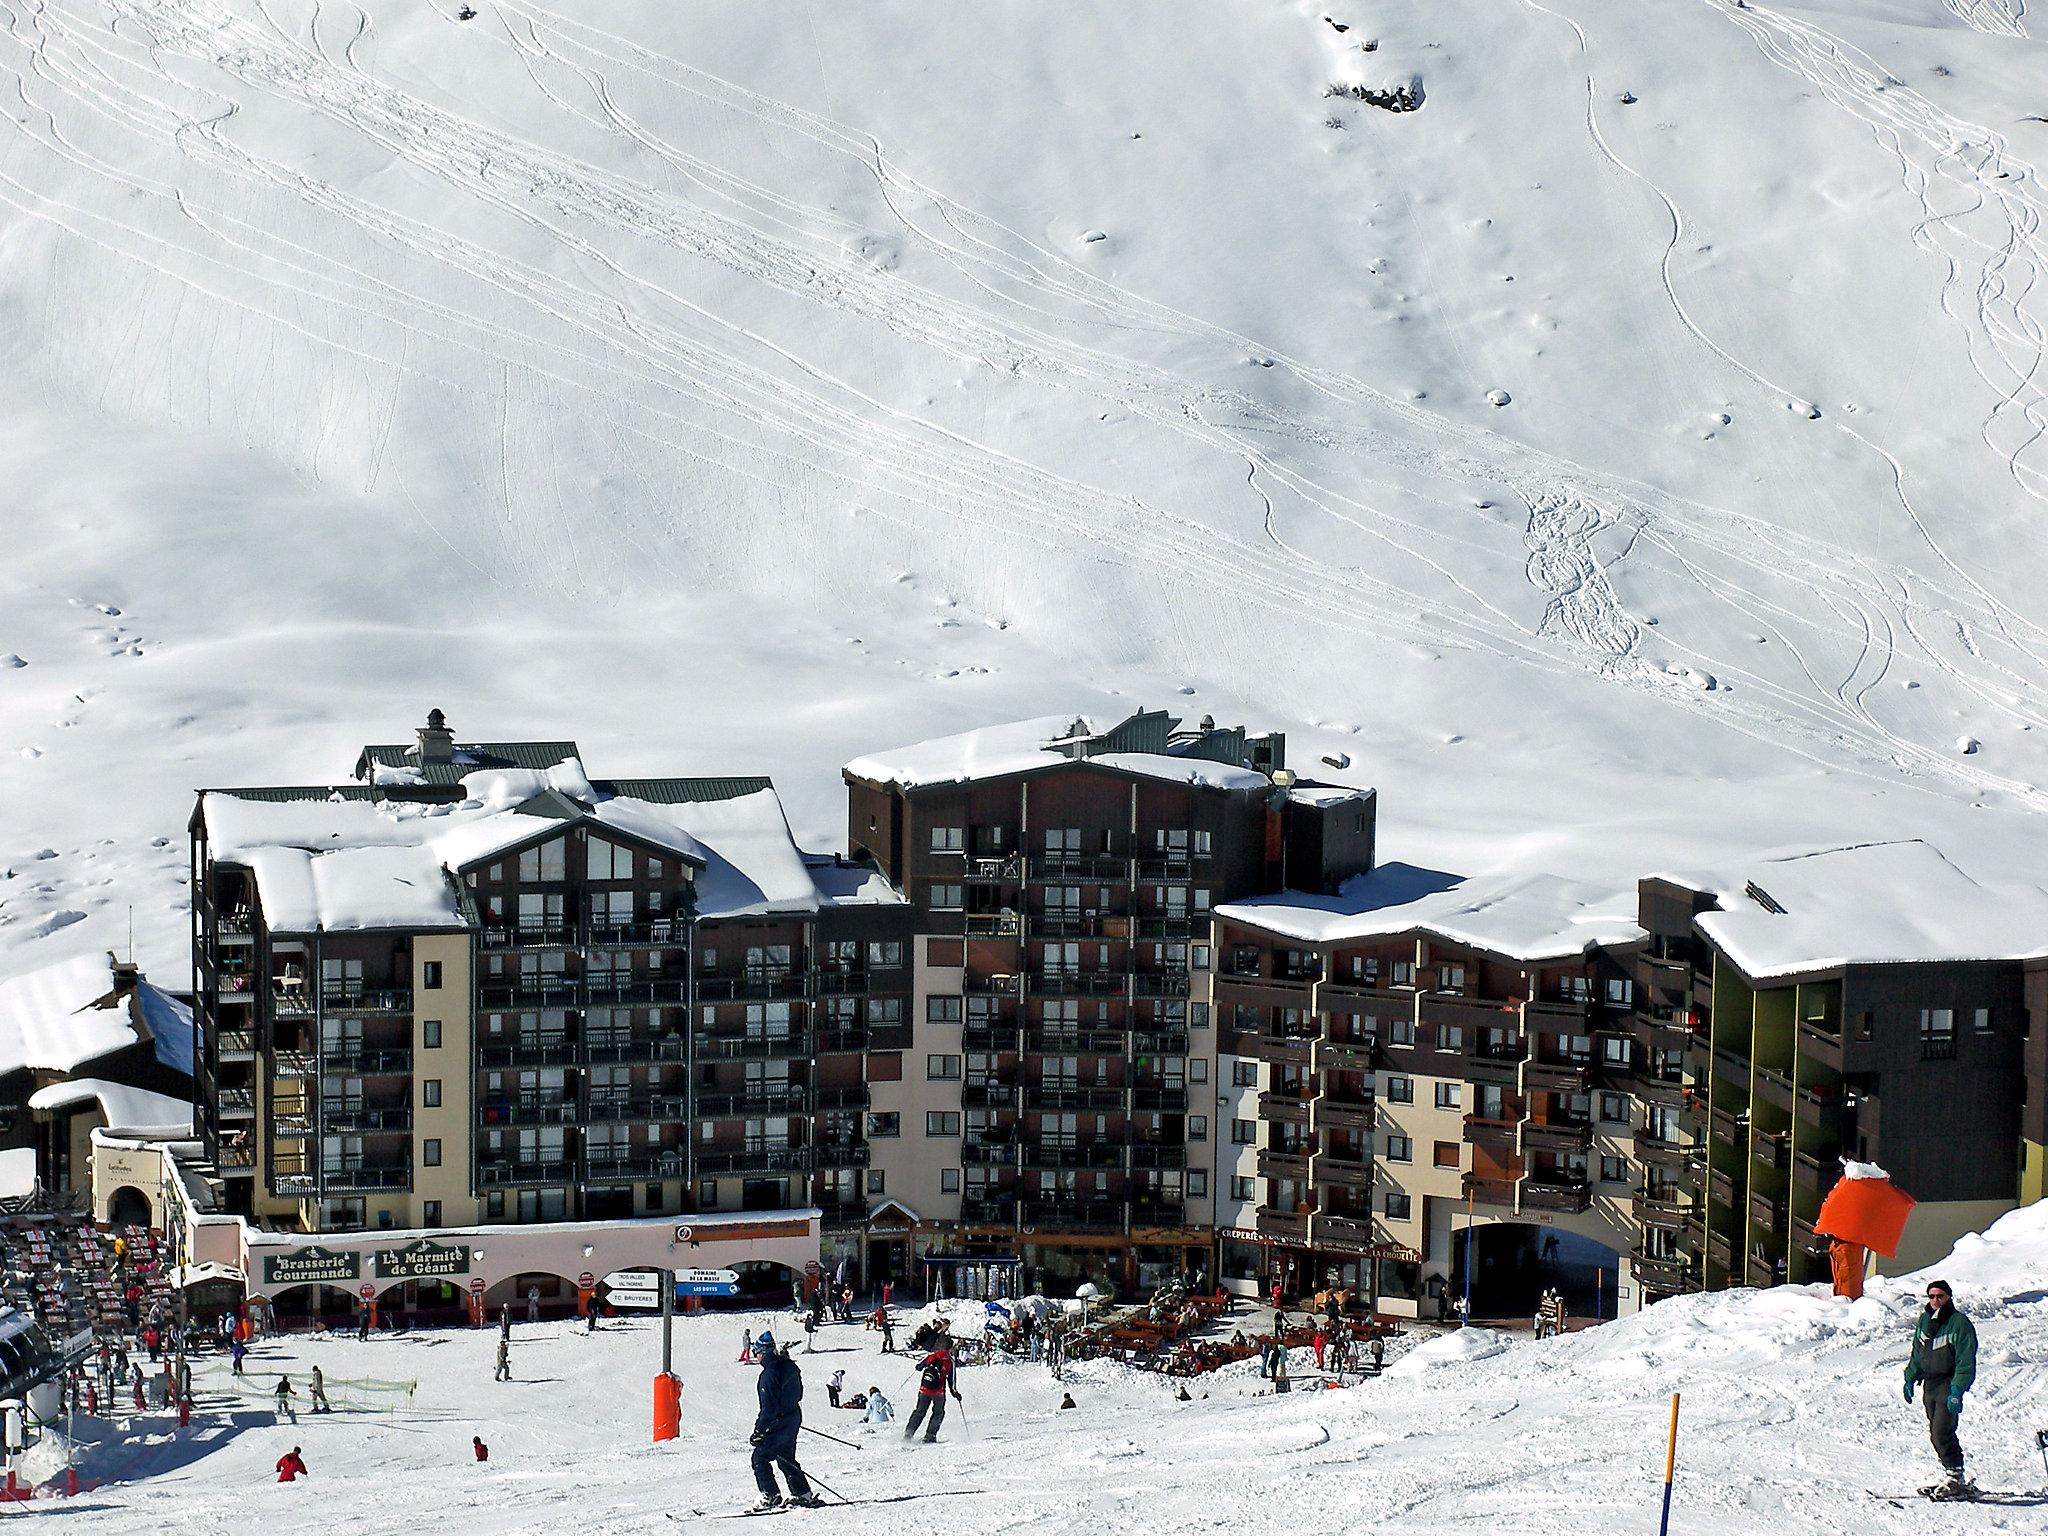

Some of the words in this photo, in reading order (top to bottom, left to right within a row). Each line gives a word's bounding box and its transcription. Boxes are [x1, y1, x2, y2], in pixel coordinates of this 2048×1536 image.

[279, 1256, 345, 1269] Brasserie
[383, 1253, 398, 1265] La
[405, 1250, 463, 1263] Marmite
[1383, 1251, 1418, 1262] CHOUETTE
[272, 1268, 353, 1281] Gourmande
[391, 1264, 407, 1275] de
[414, 1261, 455, 1274] Géant
